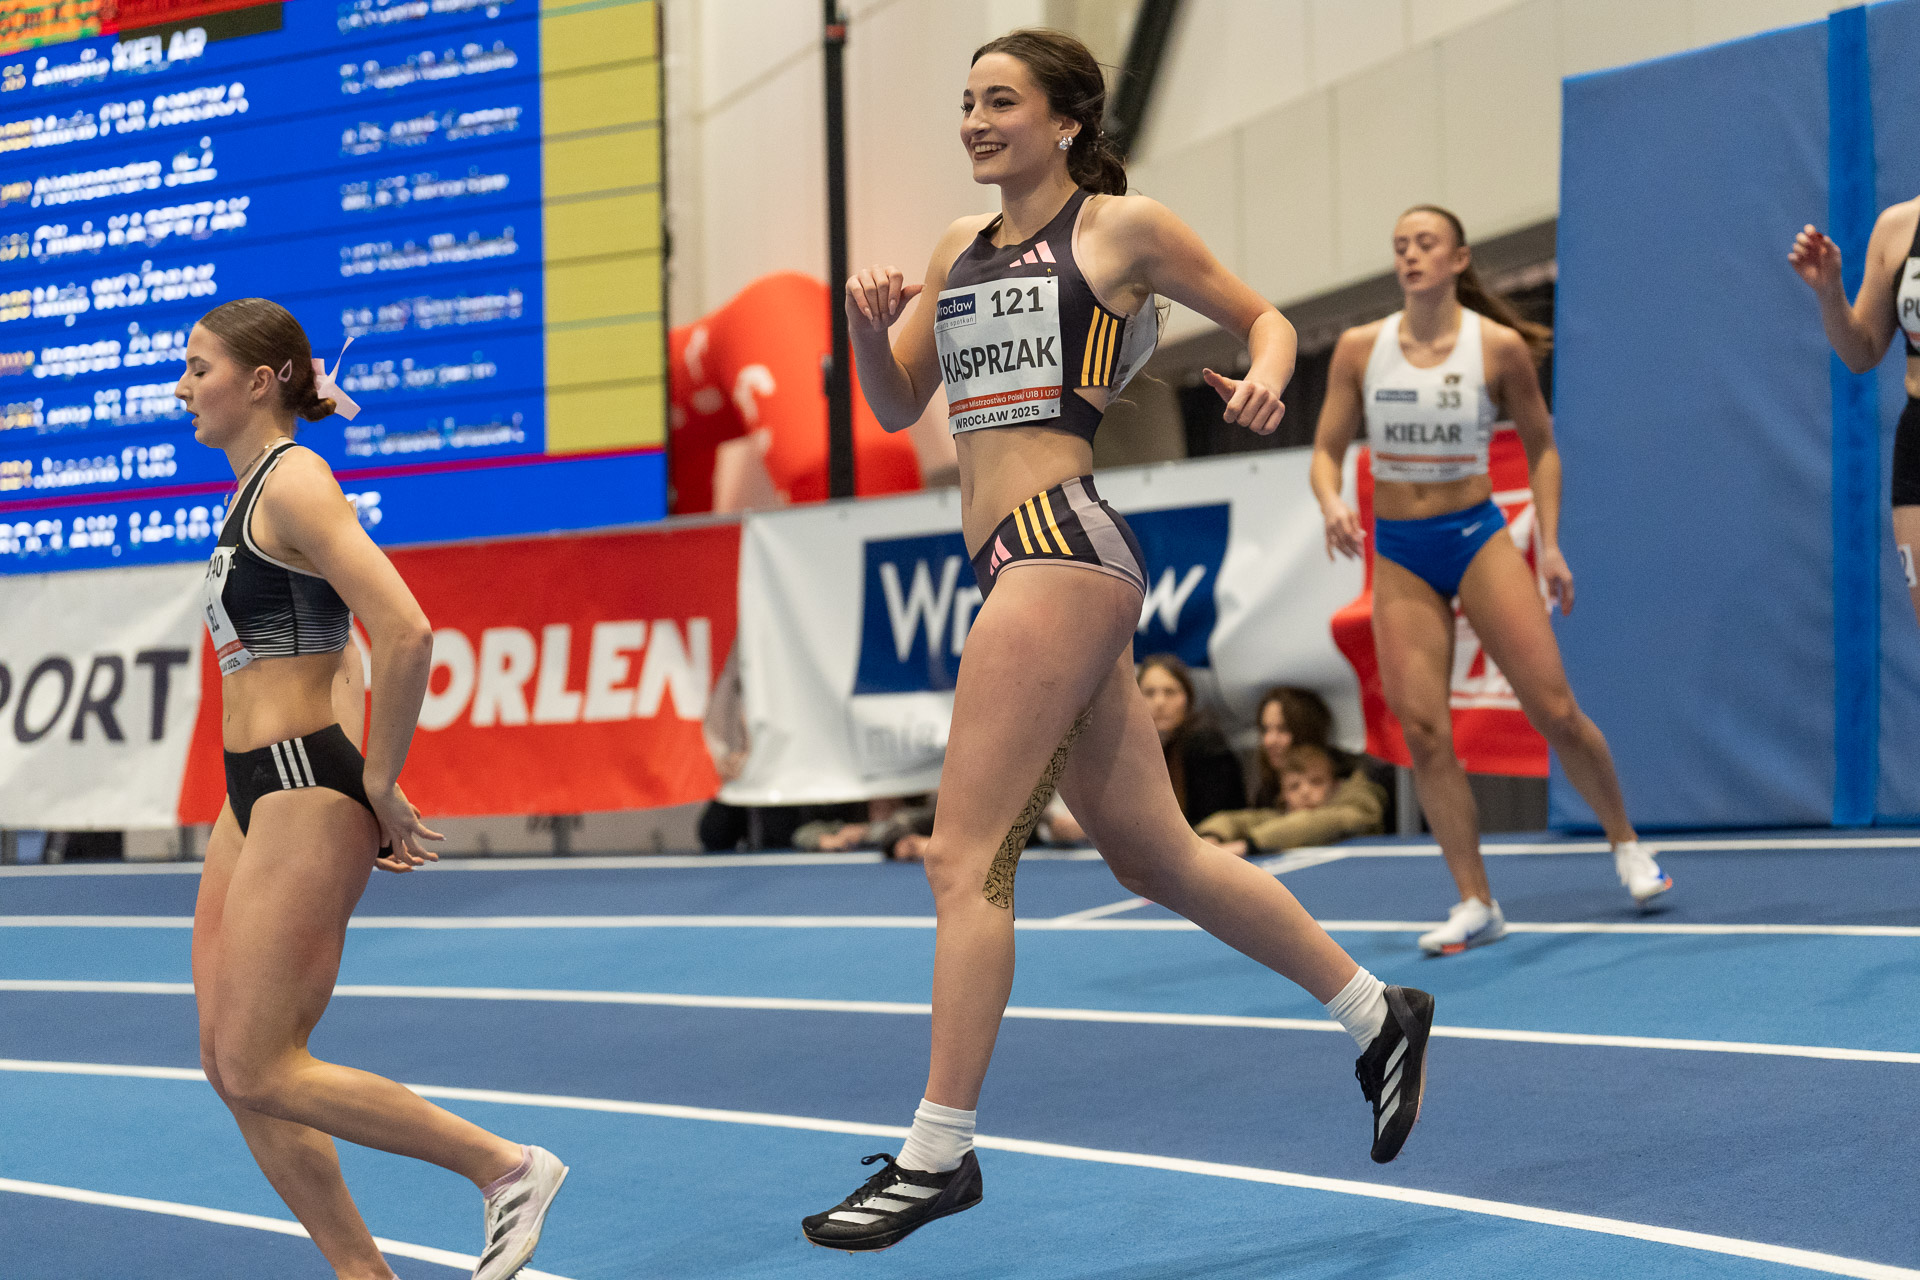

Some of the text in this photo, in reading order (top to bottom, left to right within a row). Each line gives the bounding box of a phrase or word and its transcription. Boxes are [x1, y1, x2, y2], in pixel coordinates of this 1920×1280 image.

[990, 286, 1044, 318] 121
[941, 335, 1058, 385] KASPRZAK
[968, 394, 1007, 408] Mistrzostwa
[1008, 391, 1024, 402] Polski
[1025, 390, 1039, 399] U18
[1045, 388, 1060, 397] U20
[955, 405, 1040, 430] WROCŁAW 2025
[1384, 423, 1462, 444] KIELAR
[416, 616, 712, 731] ORLEN
[0, 648, 191, 743] ORT
